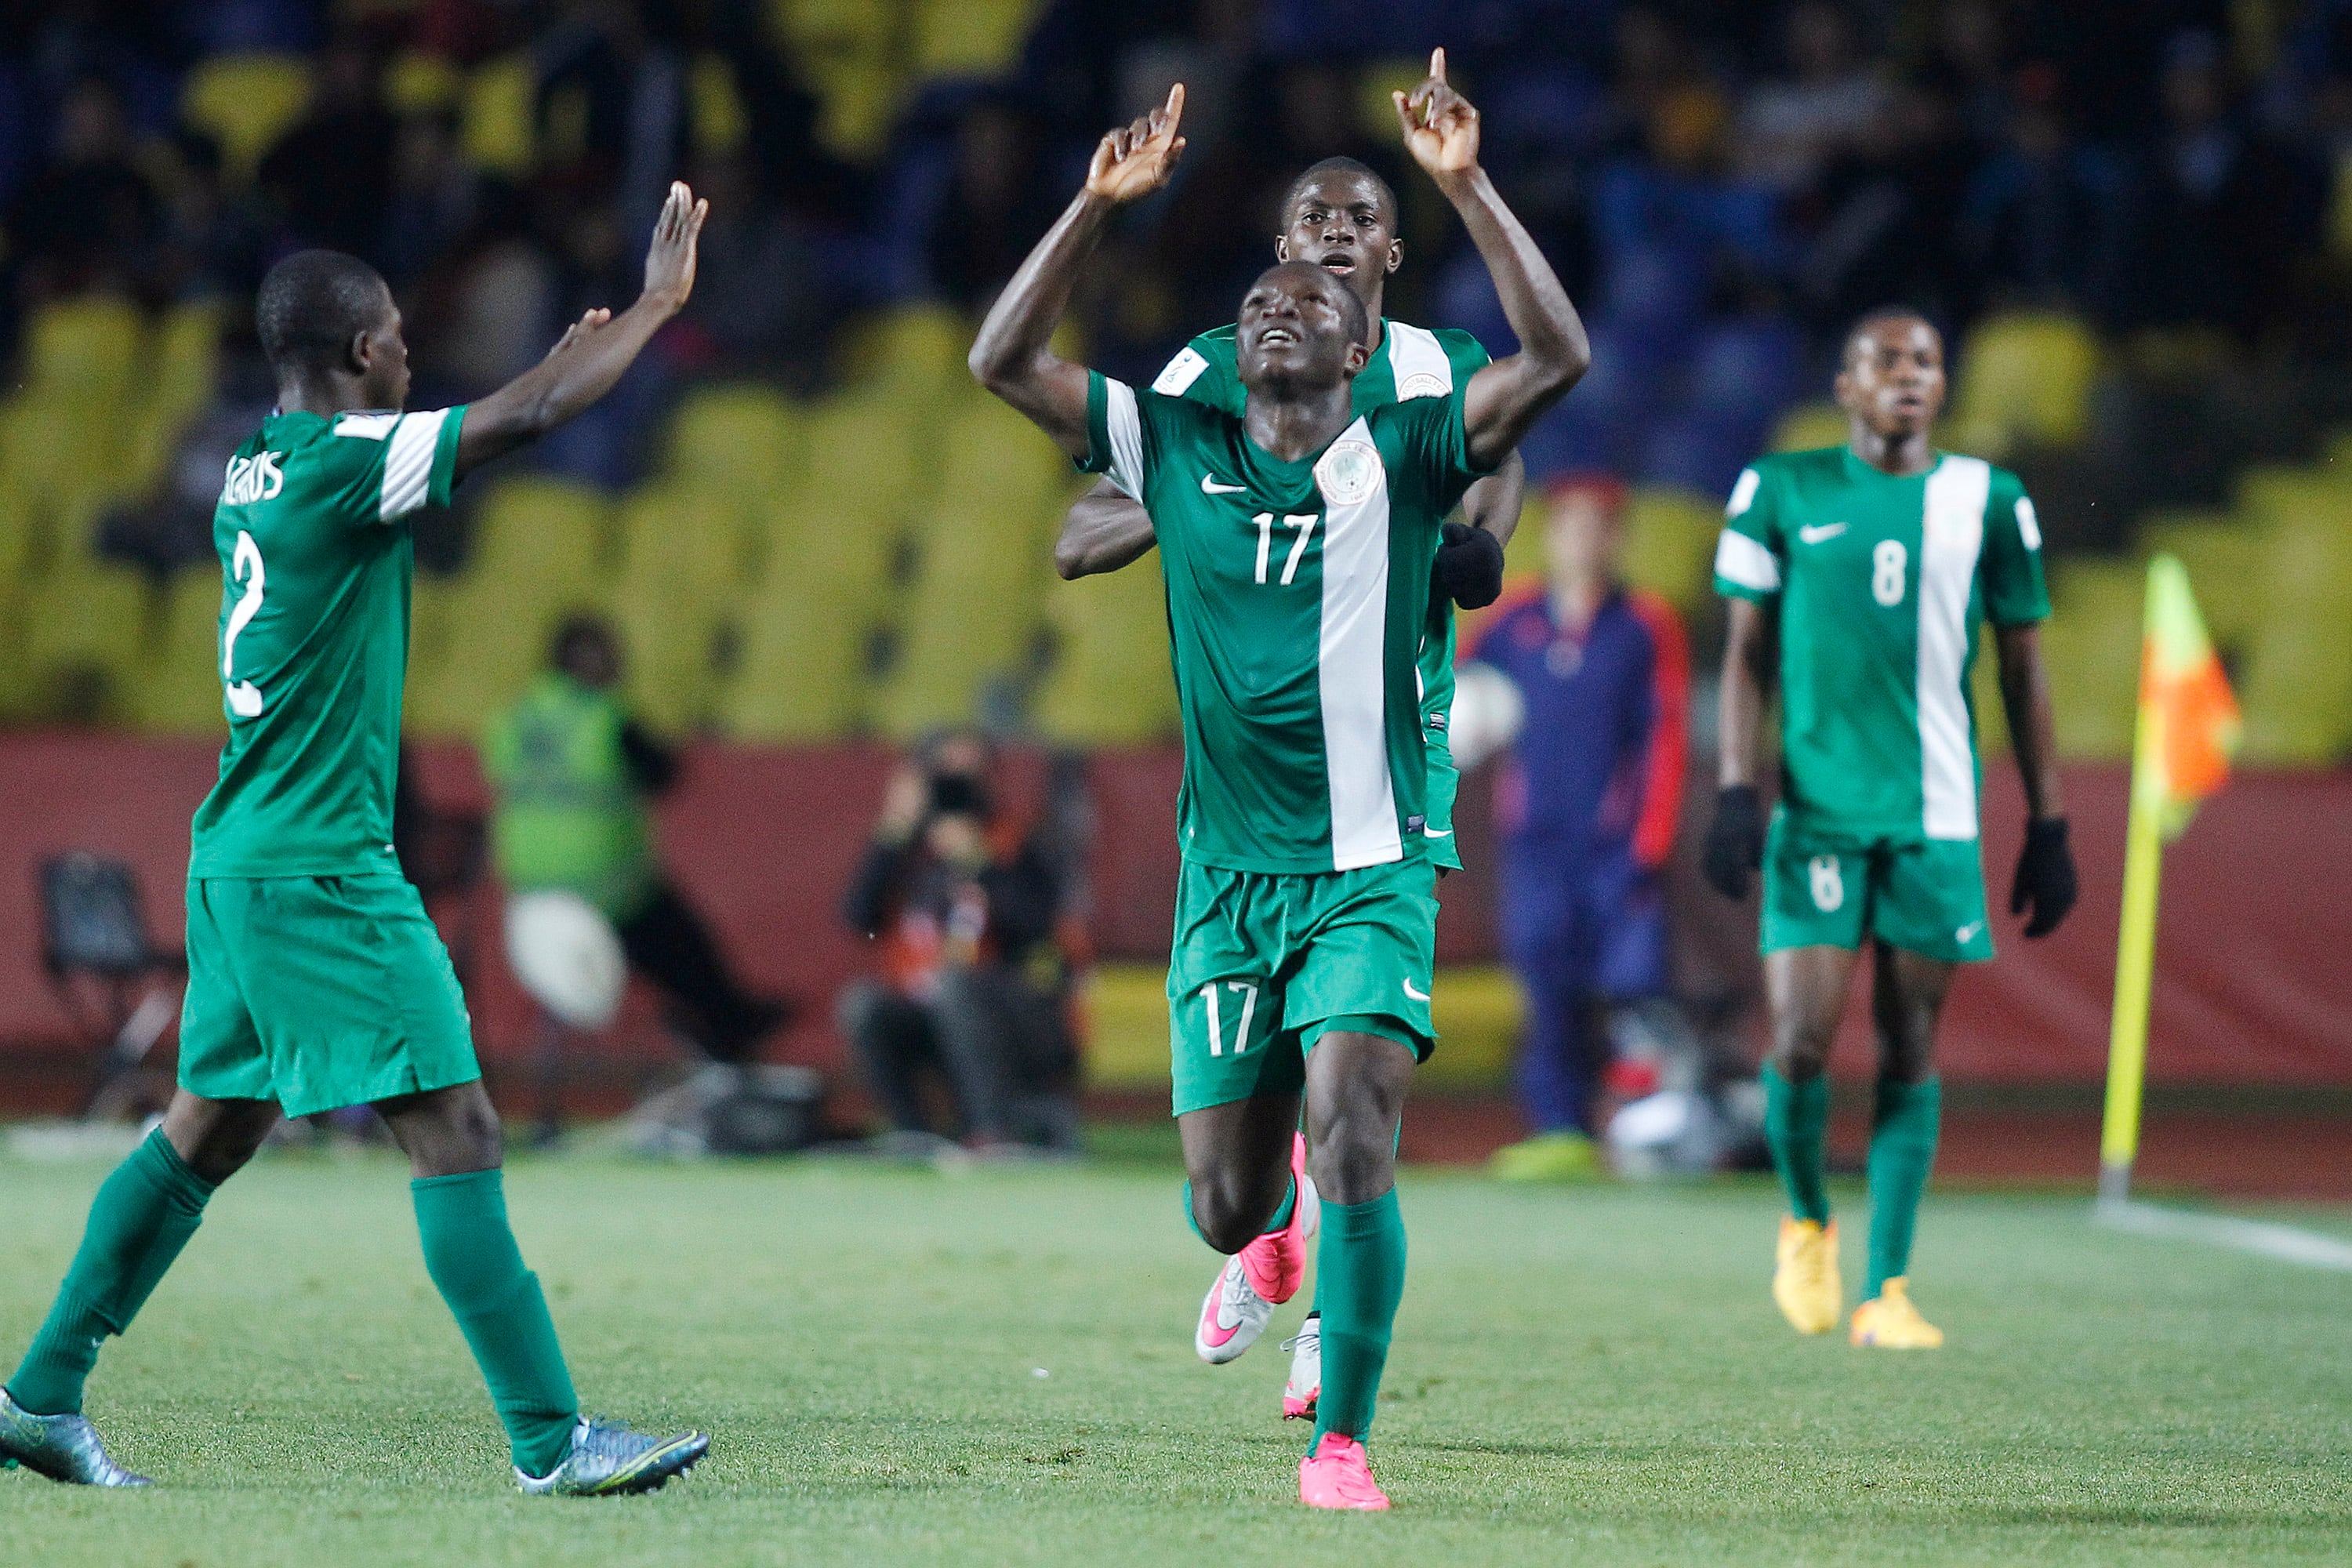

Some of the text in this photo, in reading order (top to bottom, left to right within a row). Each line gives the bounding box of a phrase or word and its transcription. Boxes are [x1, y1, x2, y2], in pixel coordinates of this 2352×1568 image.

[1251, 511, 1319, 586] 17
[1872, 539, 1907, 607] 8
[224, 530, 265, 717] 2
[1200, 981, 1258, 1057] 17
